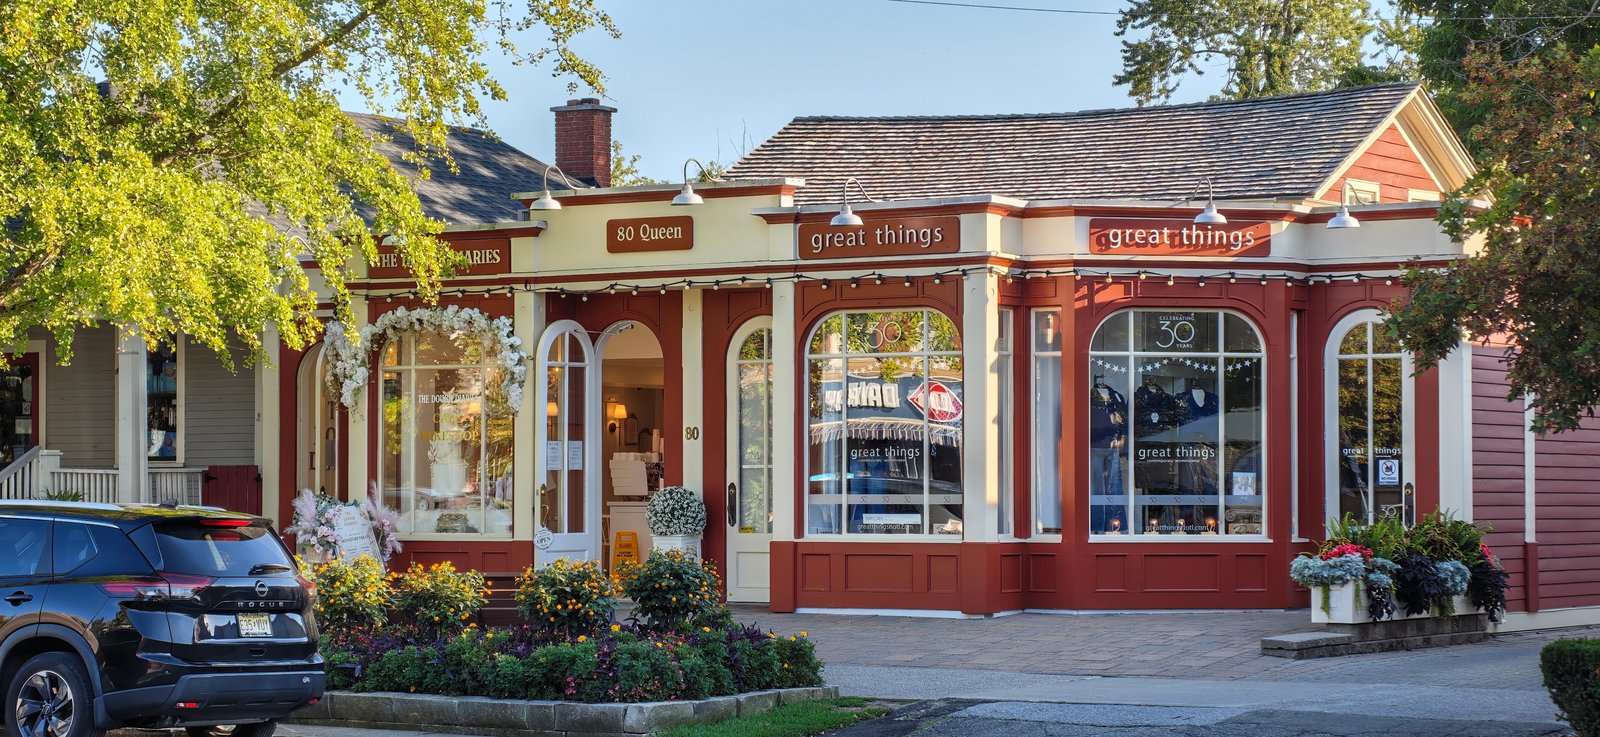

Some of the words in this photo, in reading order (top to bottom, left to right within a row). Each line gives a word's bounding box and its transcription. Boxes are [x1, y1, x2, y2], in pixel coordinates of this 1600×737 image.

[617, 226, 634, 241] 80
[640, 223, 682, 241] Queen
[811, 229, 866, 253] great
[875, 224, 943, 248] things
[1109, 227, 1171, 248] great
[1181, 224, 1255, 250] things
[453, 249, 500, 266] ARIES
[867, 321, 902, 348] 30
[1156, 320, 1195, 348] 30
[418, 394, 429, 403] THE
[684, 426, 699, 440] 80
[851, 447, 880, 460] great
[885, 446, 920, 459] things
[1138, 448, 1171, 460] great
[1176, 446, 1215, 460] things
[1342, 447, 1364, 455] great
[1375, 447, 1402, 455] things
